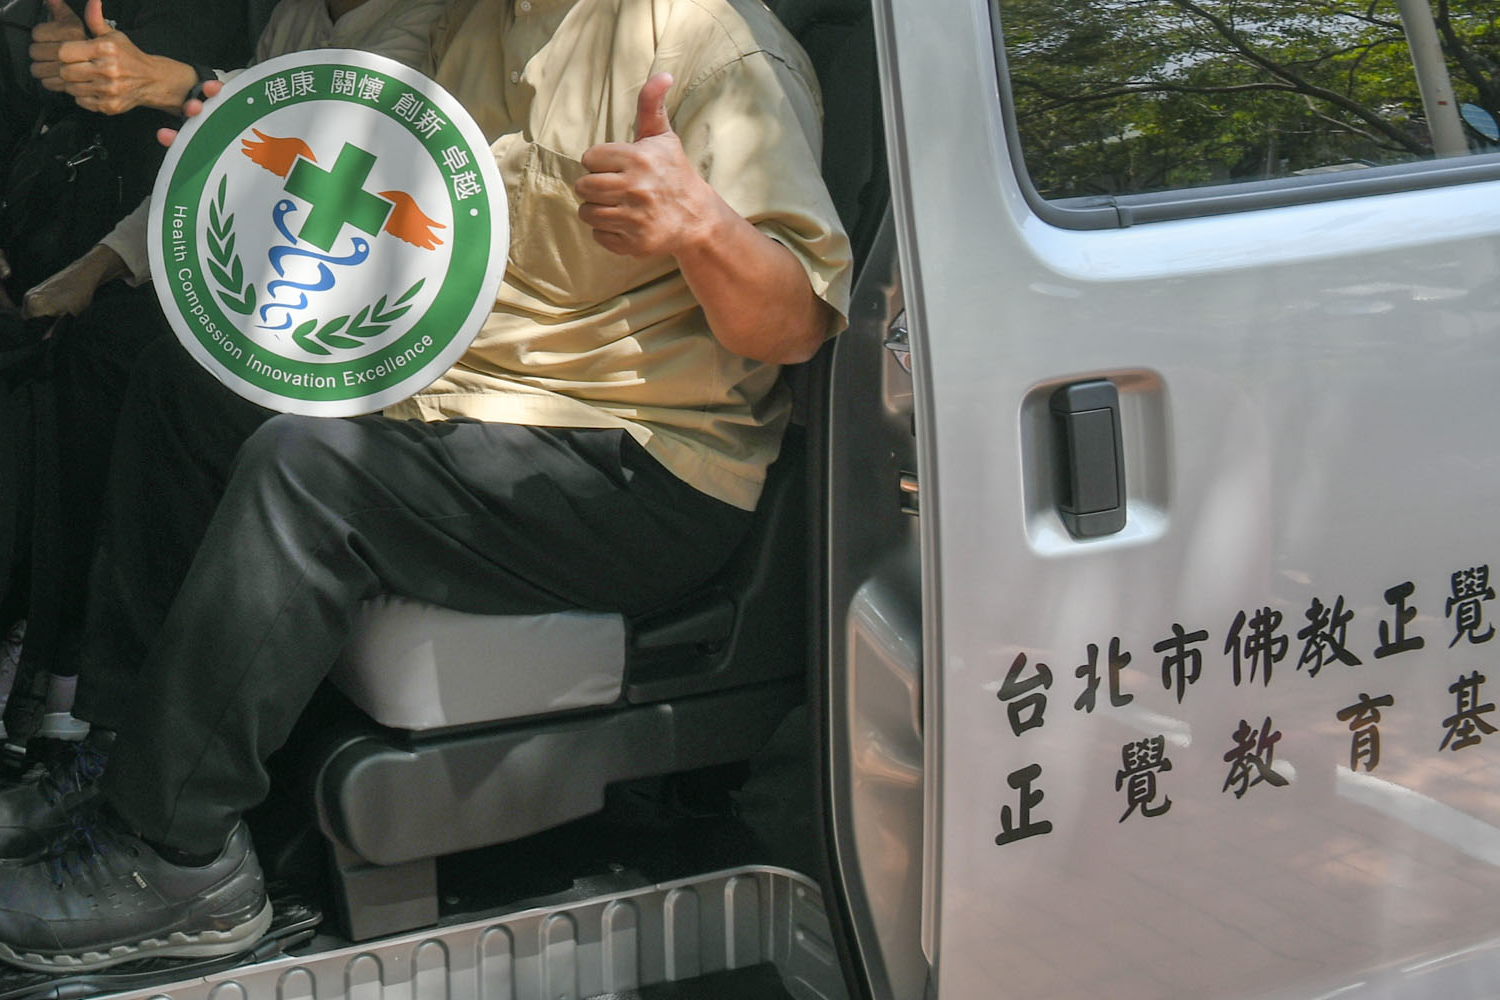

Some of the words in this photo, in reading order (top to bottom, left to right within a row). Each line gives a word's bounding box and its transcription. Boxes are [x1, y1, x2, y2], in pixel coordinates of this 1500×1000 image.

[264, 69, 317, 105] 健康
[330, 69, 385, 103] 關懷
[391, 92, 447, 140] 創新
[440, 144, 482, 201] 卓越
[172, 204, 189, 262] Health
[177, 267, 243, 359] Compassion
[246, 352, 336, 389] Innovation
[343, 333, 434, 387] Excellence
[996, 564, 1497, 737] 台北市佛教正覺
[994, 670, 1499, 846] 正覺教育基
